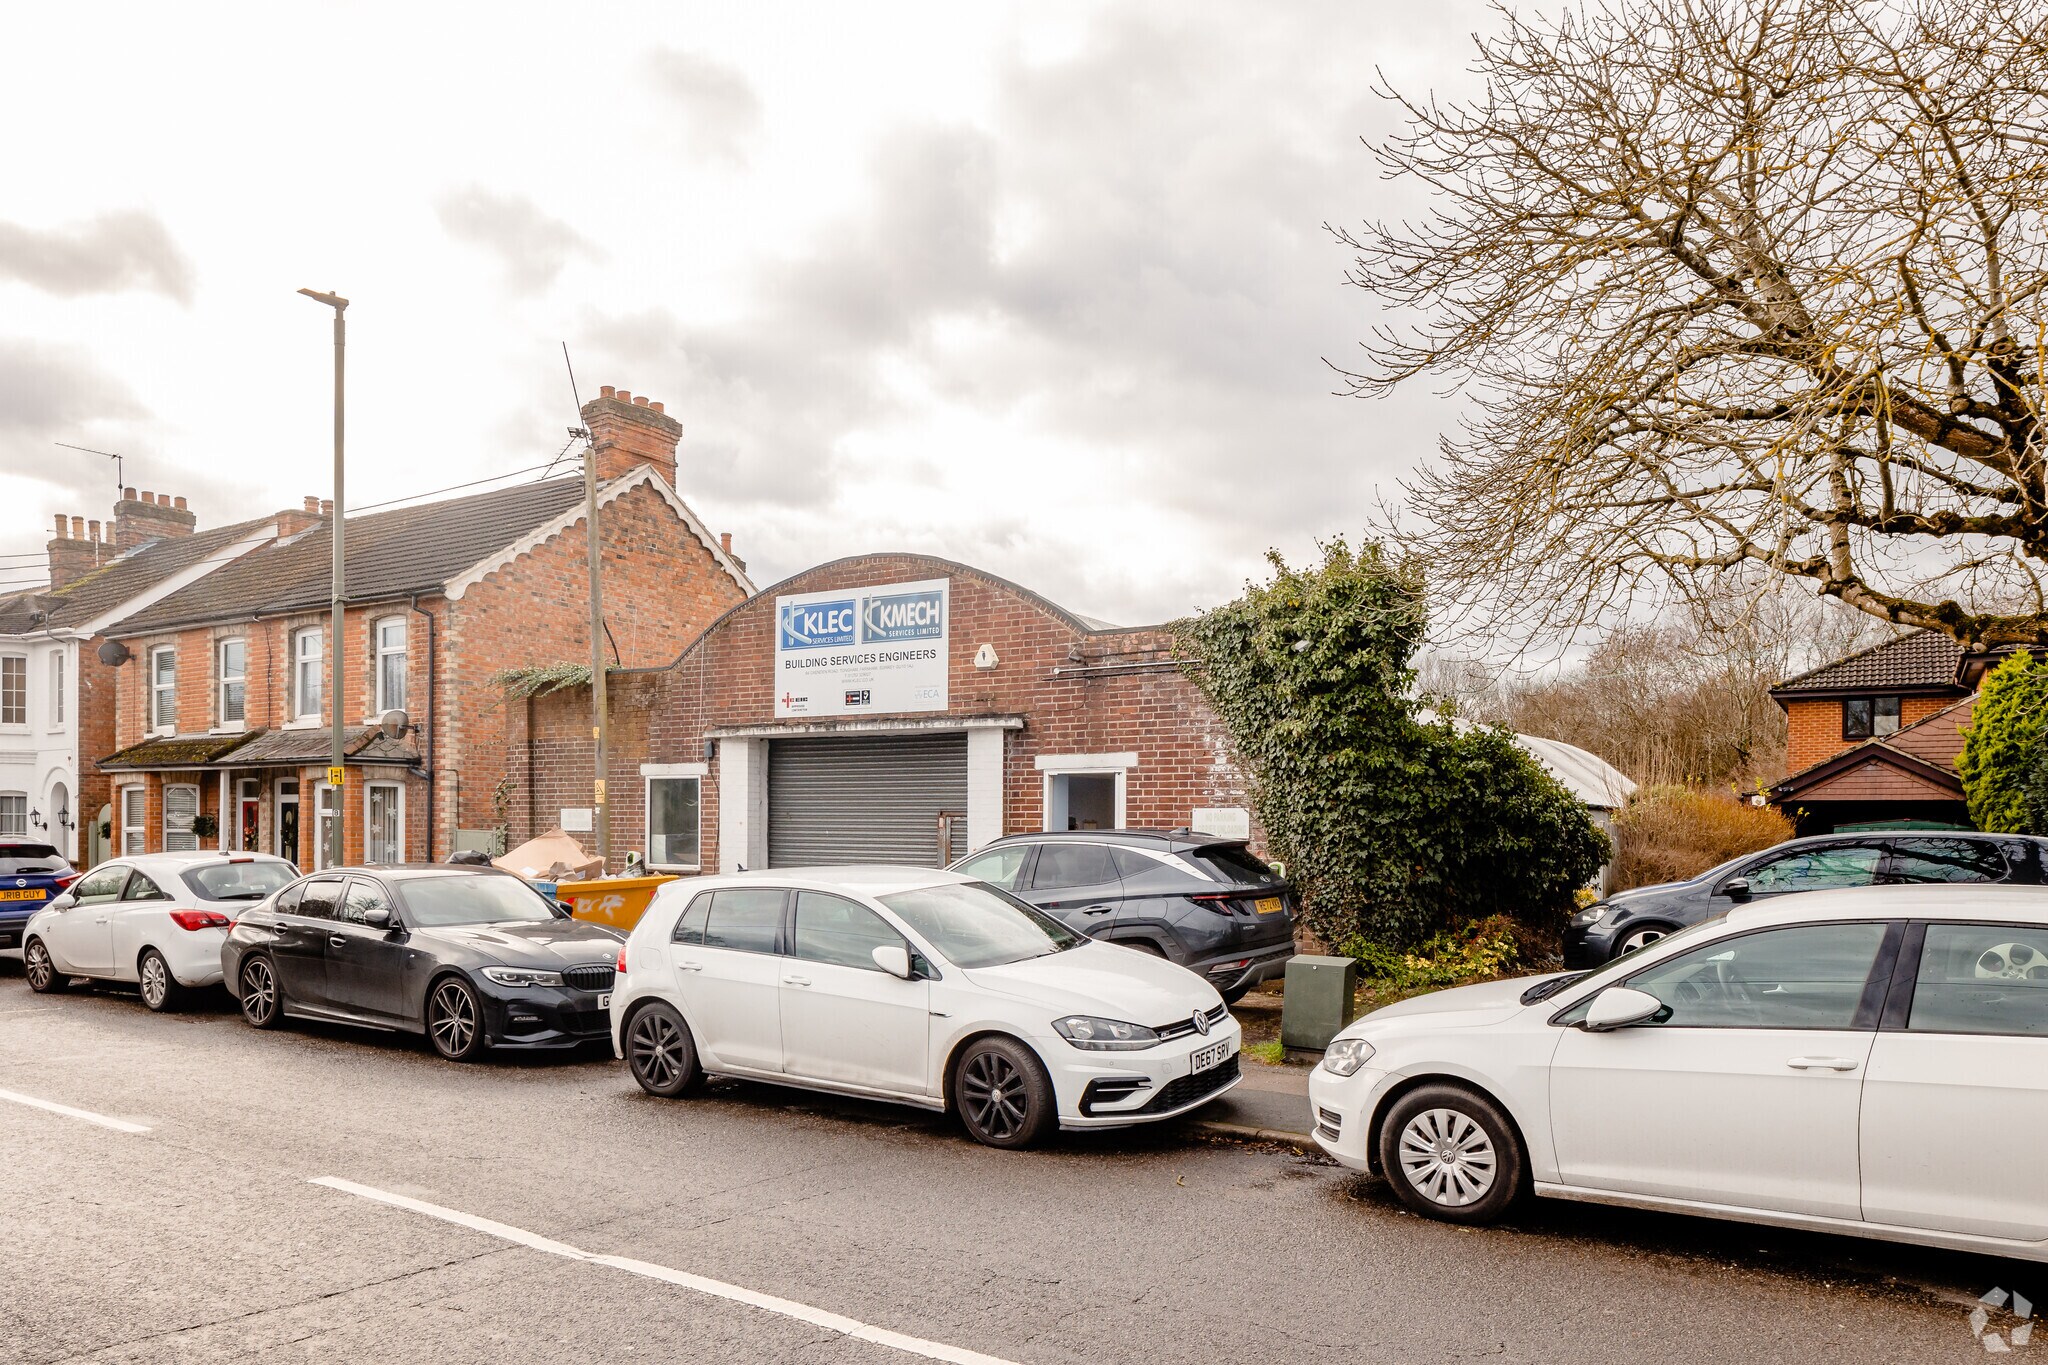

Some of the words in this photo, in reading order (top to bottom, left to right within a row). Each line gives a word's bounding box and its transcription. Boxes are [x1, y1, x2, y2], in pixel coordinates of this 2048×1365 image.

[804, 608, 853, 635] KLEC
[880, 600, 940, 628] KMECH
[812, 636, 834, 645] SERVICES
[834, 634, 853, 643] LIMITED
[889, 629, 915, 638] SERVICES
[916, 626, 940, 636] LIMITED
[785, 657, 828, 669] BUILDING
[830, 653, 876, 665] SERVICES
[879, 649, 937, 662] ENGINEERS
[923, 689, 940, 698] ECA
[23, 890, 41, 899] GUY
[1195, 1048, 1215, 1070] DE67
[1217, 1041, 1230, 1060] SRV
